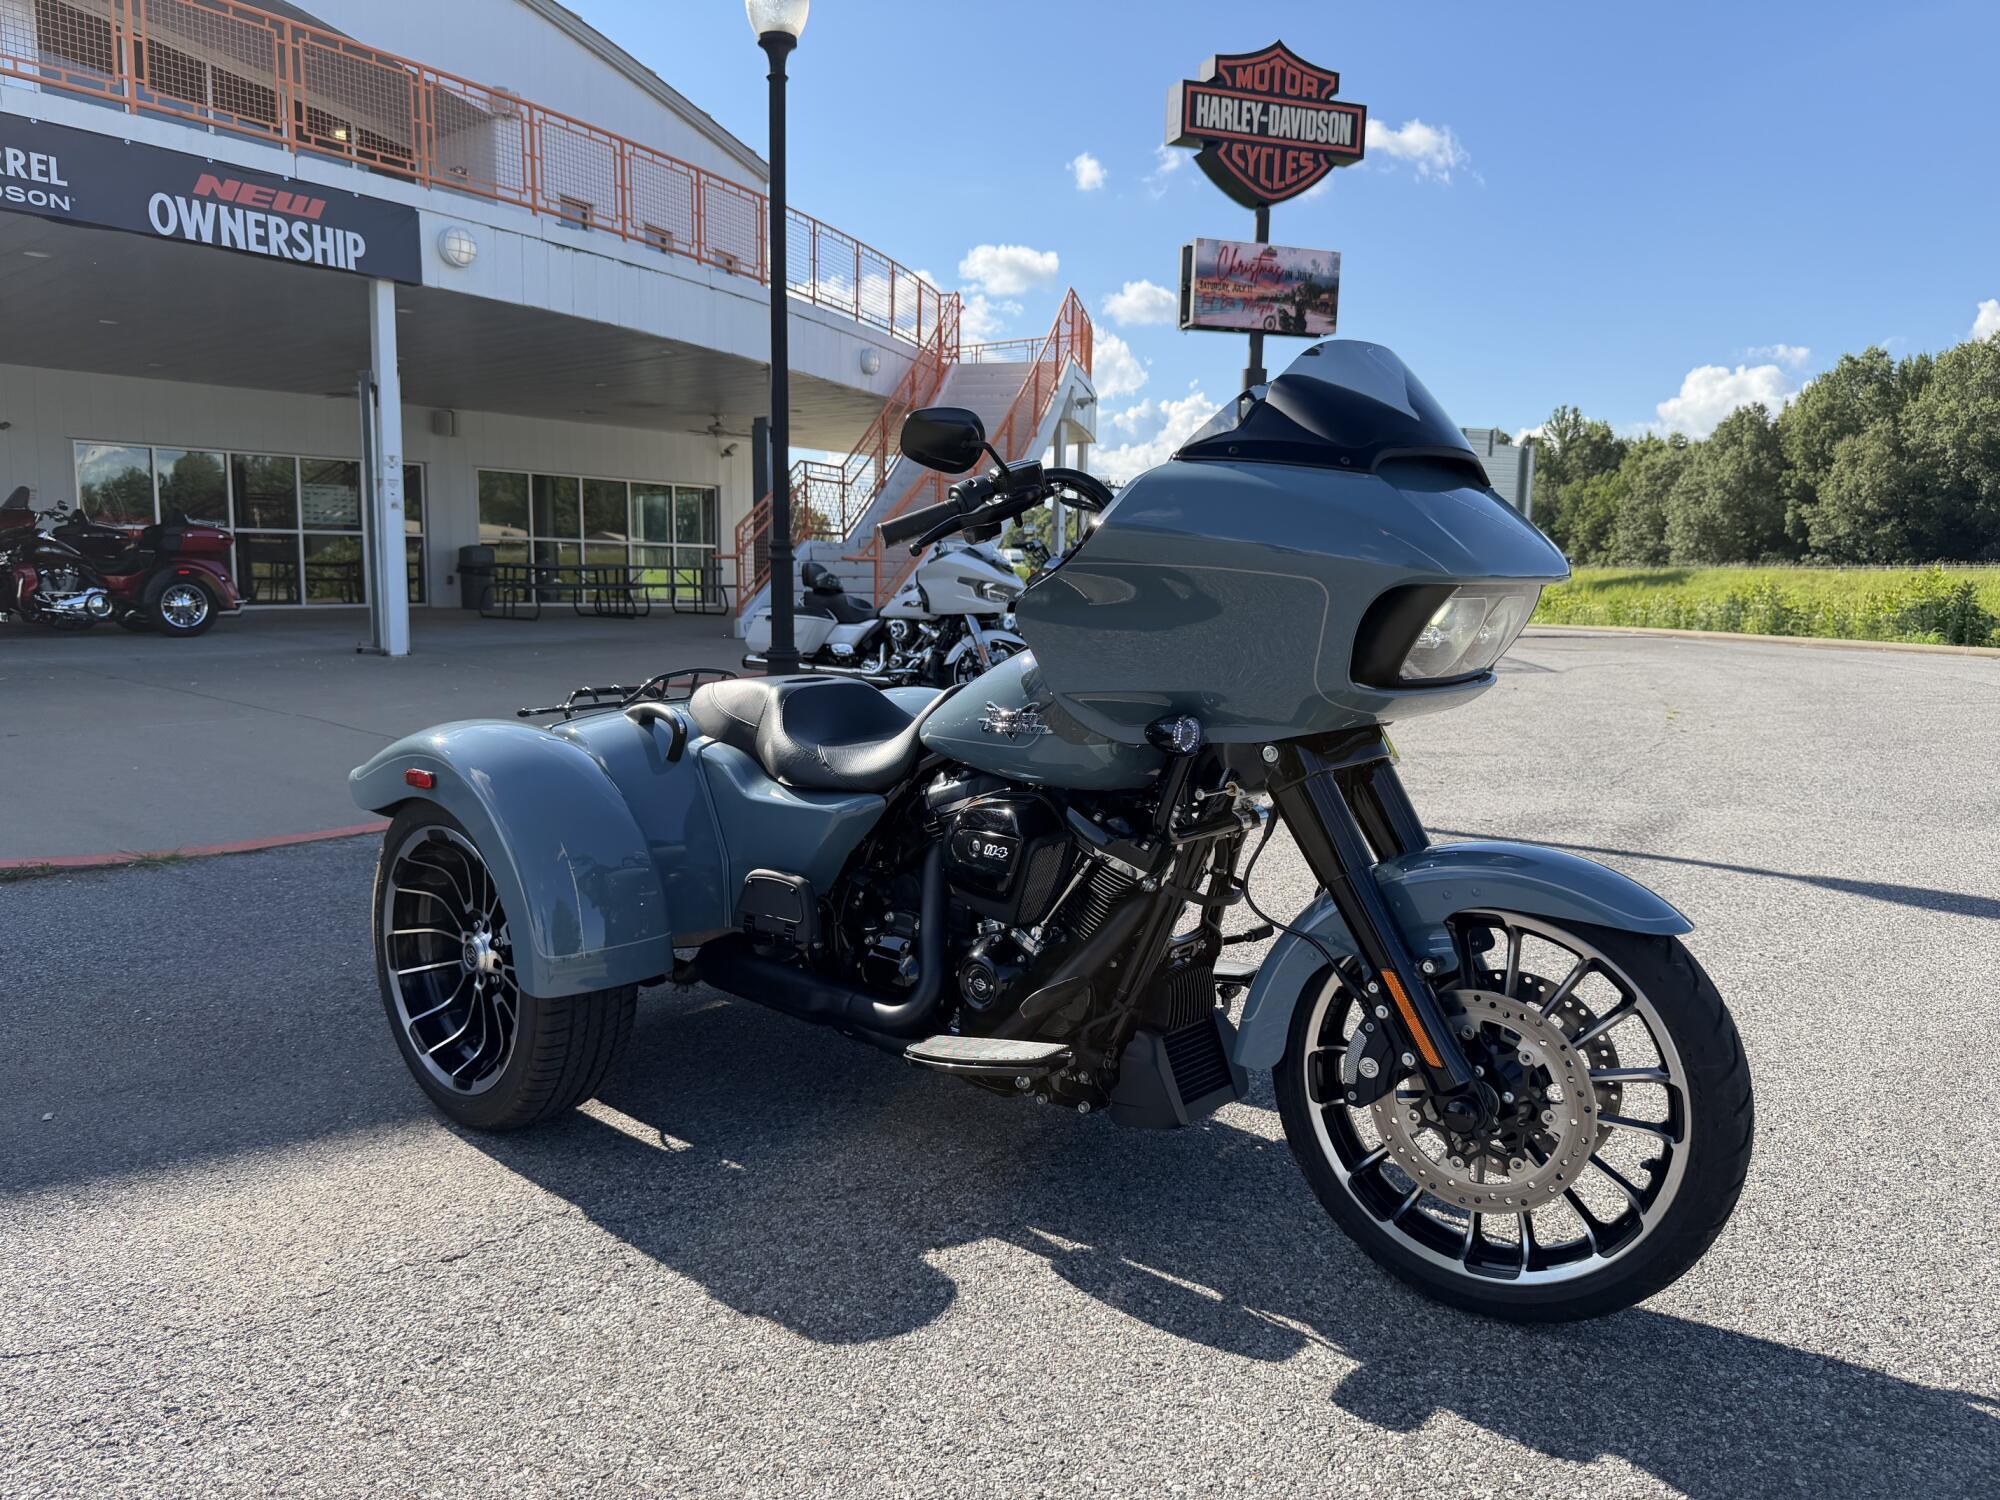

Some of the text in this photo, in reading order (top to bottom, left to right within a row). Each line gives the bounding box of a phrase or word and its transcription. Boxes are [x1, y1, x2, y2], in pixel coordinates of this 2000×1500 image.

[1236, 56, 1318, 98] MOTOR
[1196, 94, 1352, 146] HARLEY-DAVIDSON
[0, 146, 68, 187] REL
[1232, 144, 1315, 190] CYCLES
[0, 185, 71, 211] SON
[193, 174, 327, 220] NEW
[148, 192, 367, 272] OWNERSHIP
[1216, 246, 1285, 284] Christmas
[983, 844, 1008, 858] 114
